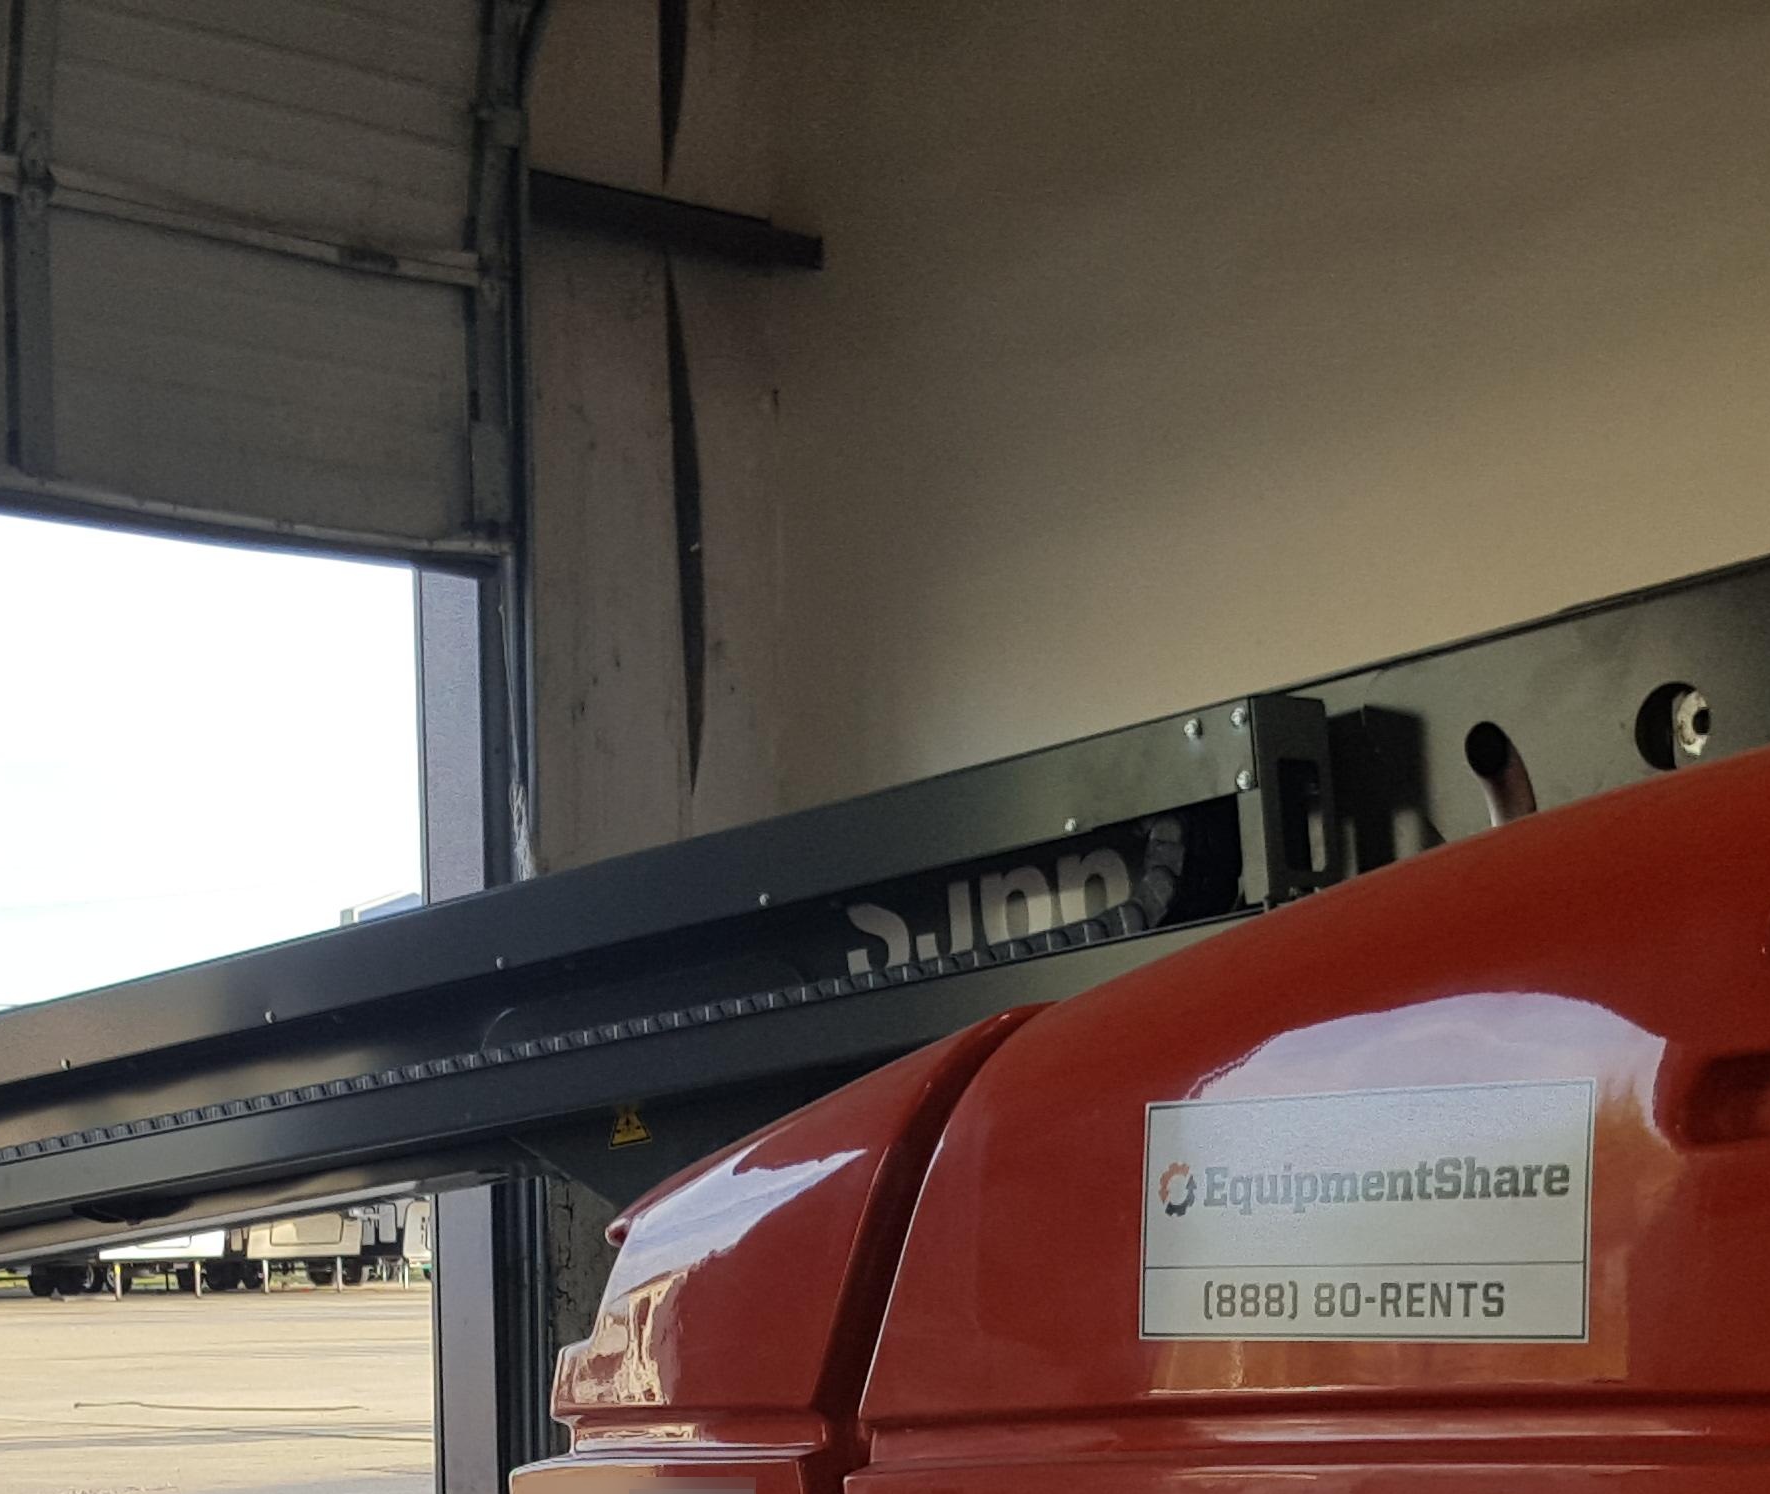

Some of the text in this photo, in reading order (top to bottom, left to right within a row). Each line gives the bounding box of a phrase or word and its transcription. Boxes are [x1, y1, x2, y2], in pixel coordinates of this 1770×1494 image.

[1203, 1156, 1571, 1216] EquipmentShare
[1203, 1280, 1505, 1320] (888) 80-RENTS
